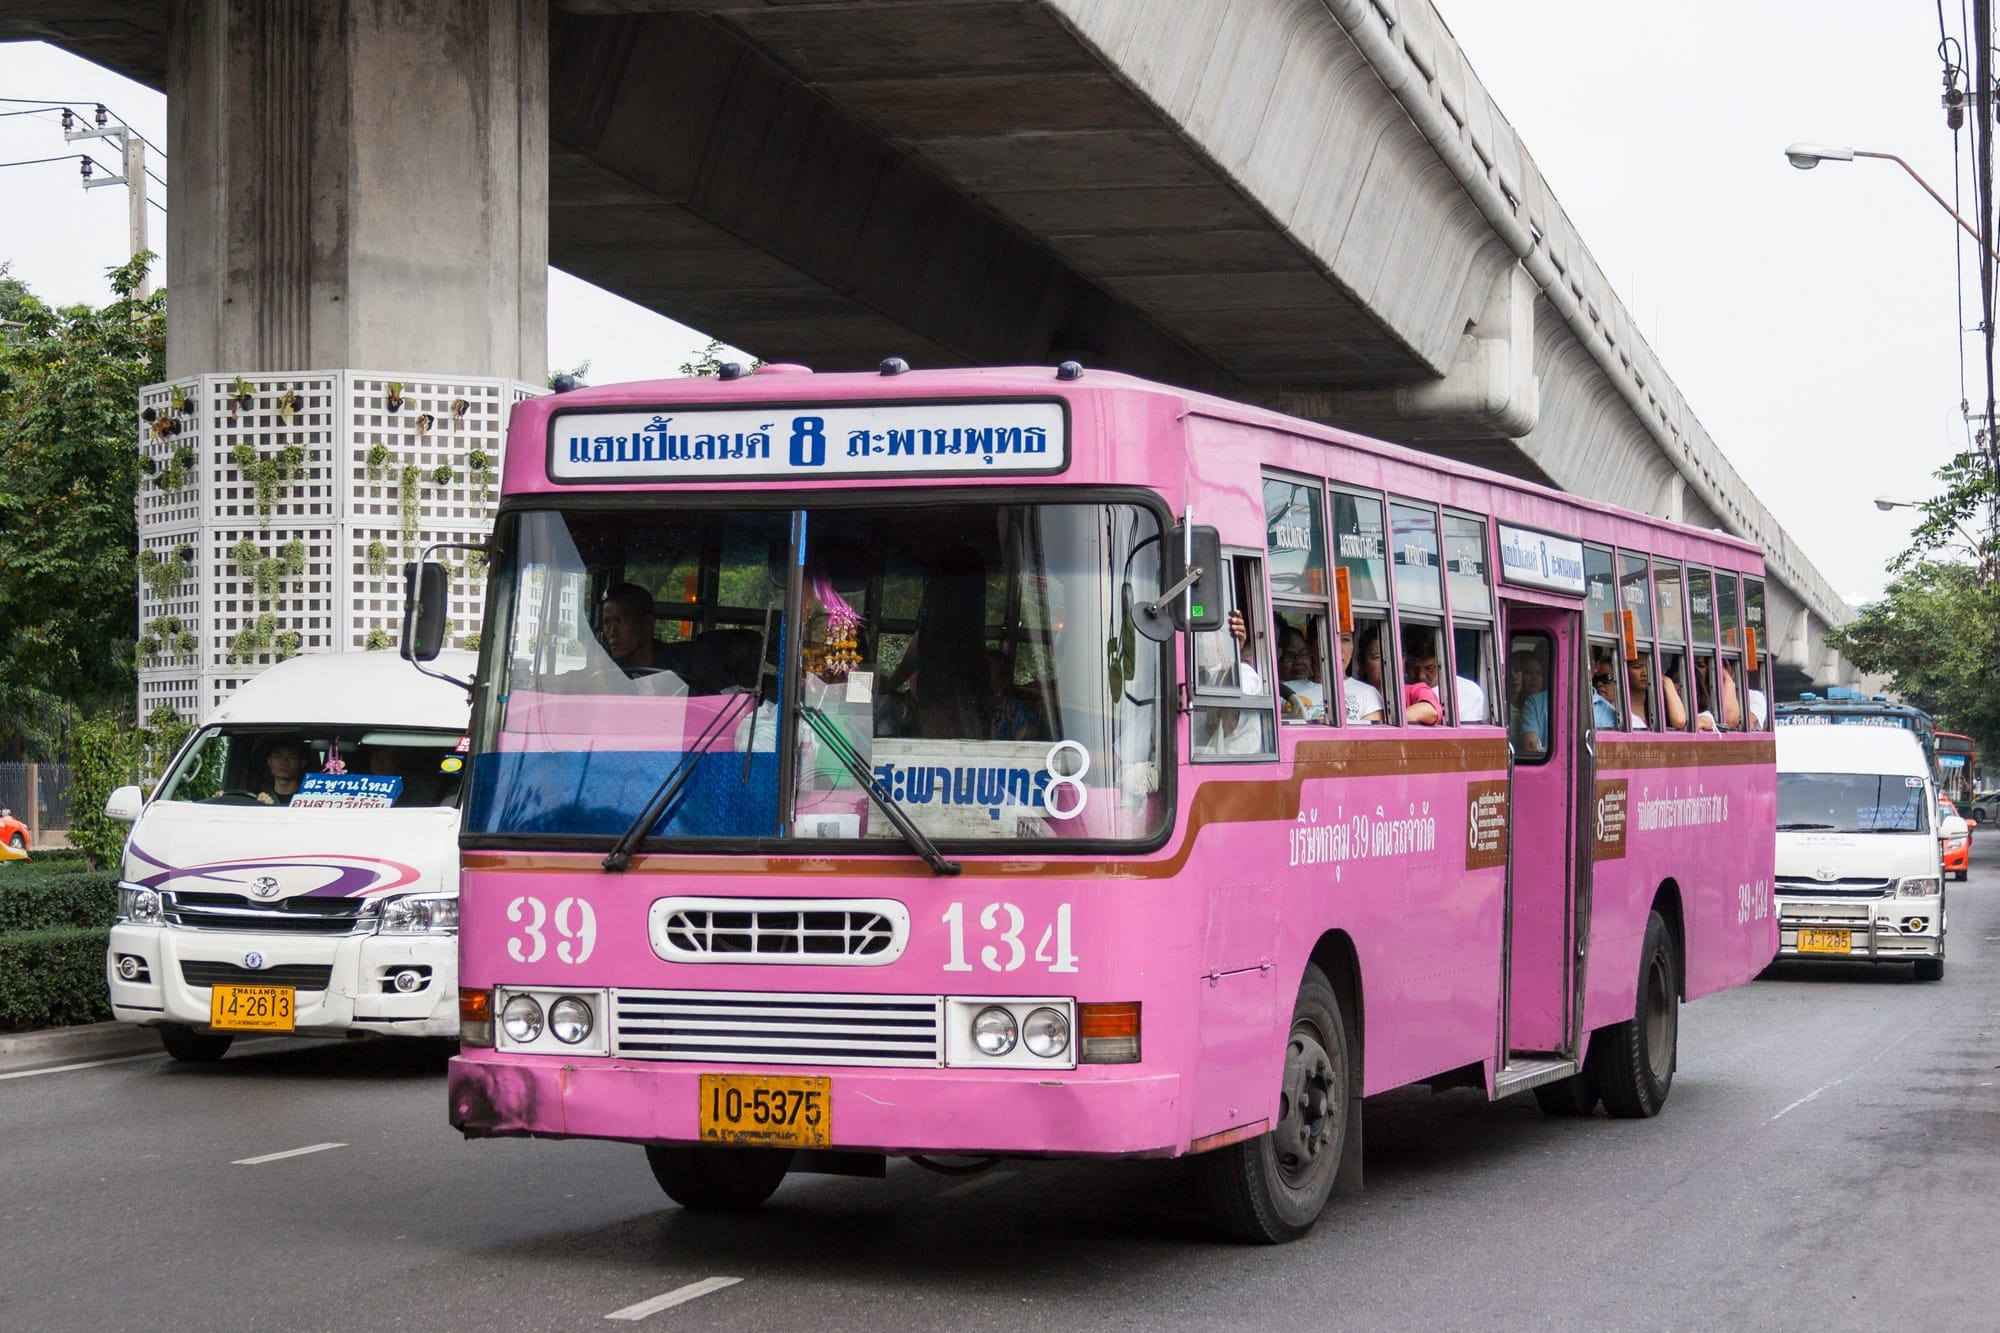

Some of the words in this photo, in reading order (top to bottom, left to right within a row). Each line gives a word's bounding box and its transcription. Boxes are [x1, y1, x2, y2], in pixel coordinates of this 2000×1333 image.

[570, 416, 775, 463] แฮปปี้แลนด์
[789, 416, 826, 467] 8
[846, 427, 1047, 465] สะพานพุทธ
[1540, 540, 1549, 578] 8
[303, 778, 396, 793] สะพานใหม่
[1043, 739, 1091, 820] 8
[1351, 814, 1369, 859] 39
[1469, 801, 1479, 849] 8
[1597, 798, 1605, 841] 8
[506, 896, 597, 965] 39
[941, 901, 1079, 973] 134
[219, 995, 290, 1018] 14-2613
[231, 988, 277, 996] THAILAND
[713, 1087, 822, 1126] 10-5375
